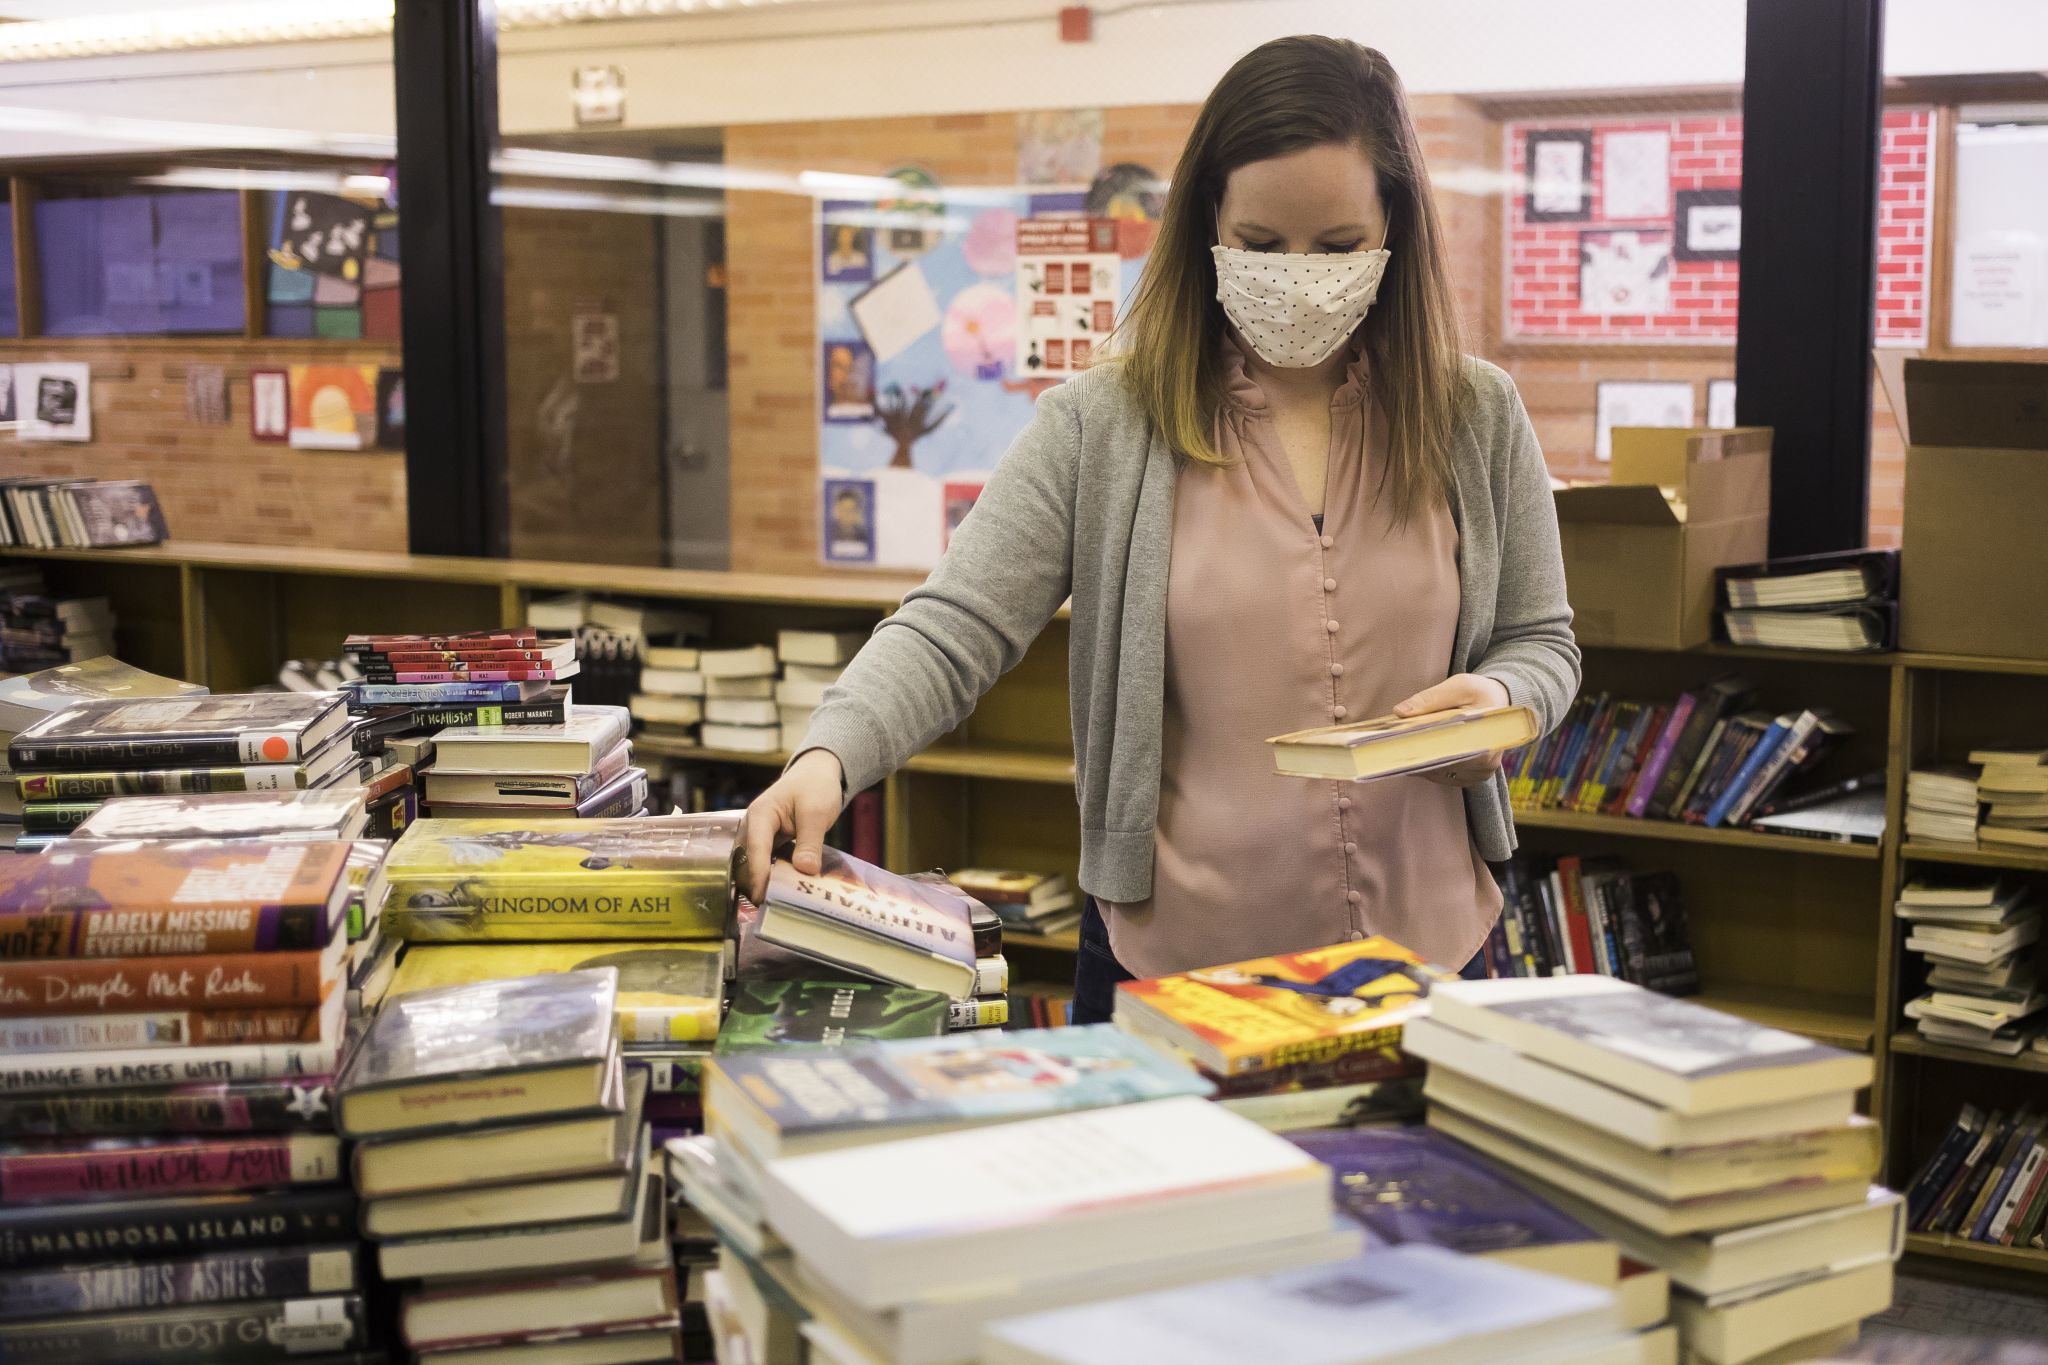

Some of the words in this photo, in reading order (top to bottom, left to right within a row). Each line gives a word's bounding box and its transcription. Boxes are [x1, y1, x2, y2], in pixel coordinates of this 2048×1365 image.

[504, 711, 525, 719] ROBERT
[526, 710, 553, 718] MARANTZ
[56, 776, 108, 794] rash
[478, 897, 589, 914] KINGDOM
[594, 898, 623, 912] OF
[629, 897, 671, 913] ASH
[87, 911, 161, 935] BARELY
[166, 908, 252, 932] MISSING
[85, 933, 207, 955] EVERYTHING
[38, 969, 137, 1008] Dimple
[147, 968, 195, 998] Met
[0, 1067, 82, 1089] HANGE
[96, 1062, 174, 1084] PLACES
[31, 1221, 178, 1250] MARIPOSA
[188, 1215, 287, 1239] ISLAND
[190, 1256, 267, 1299] ASHES
[158, 1321, 231, 1349] LOST
